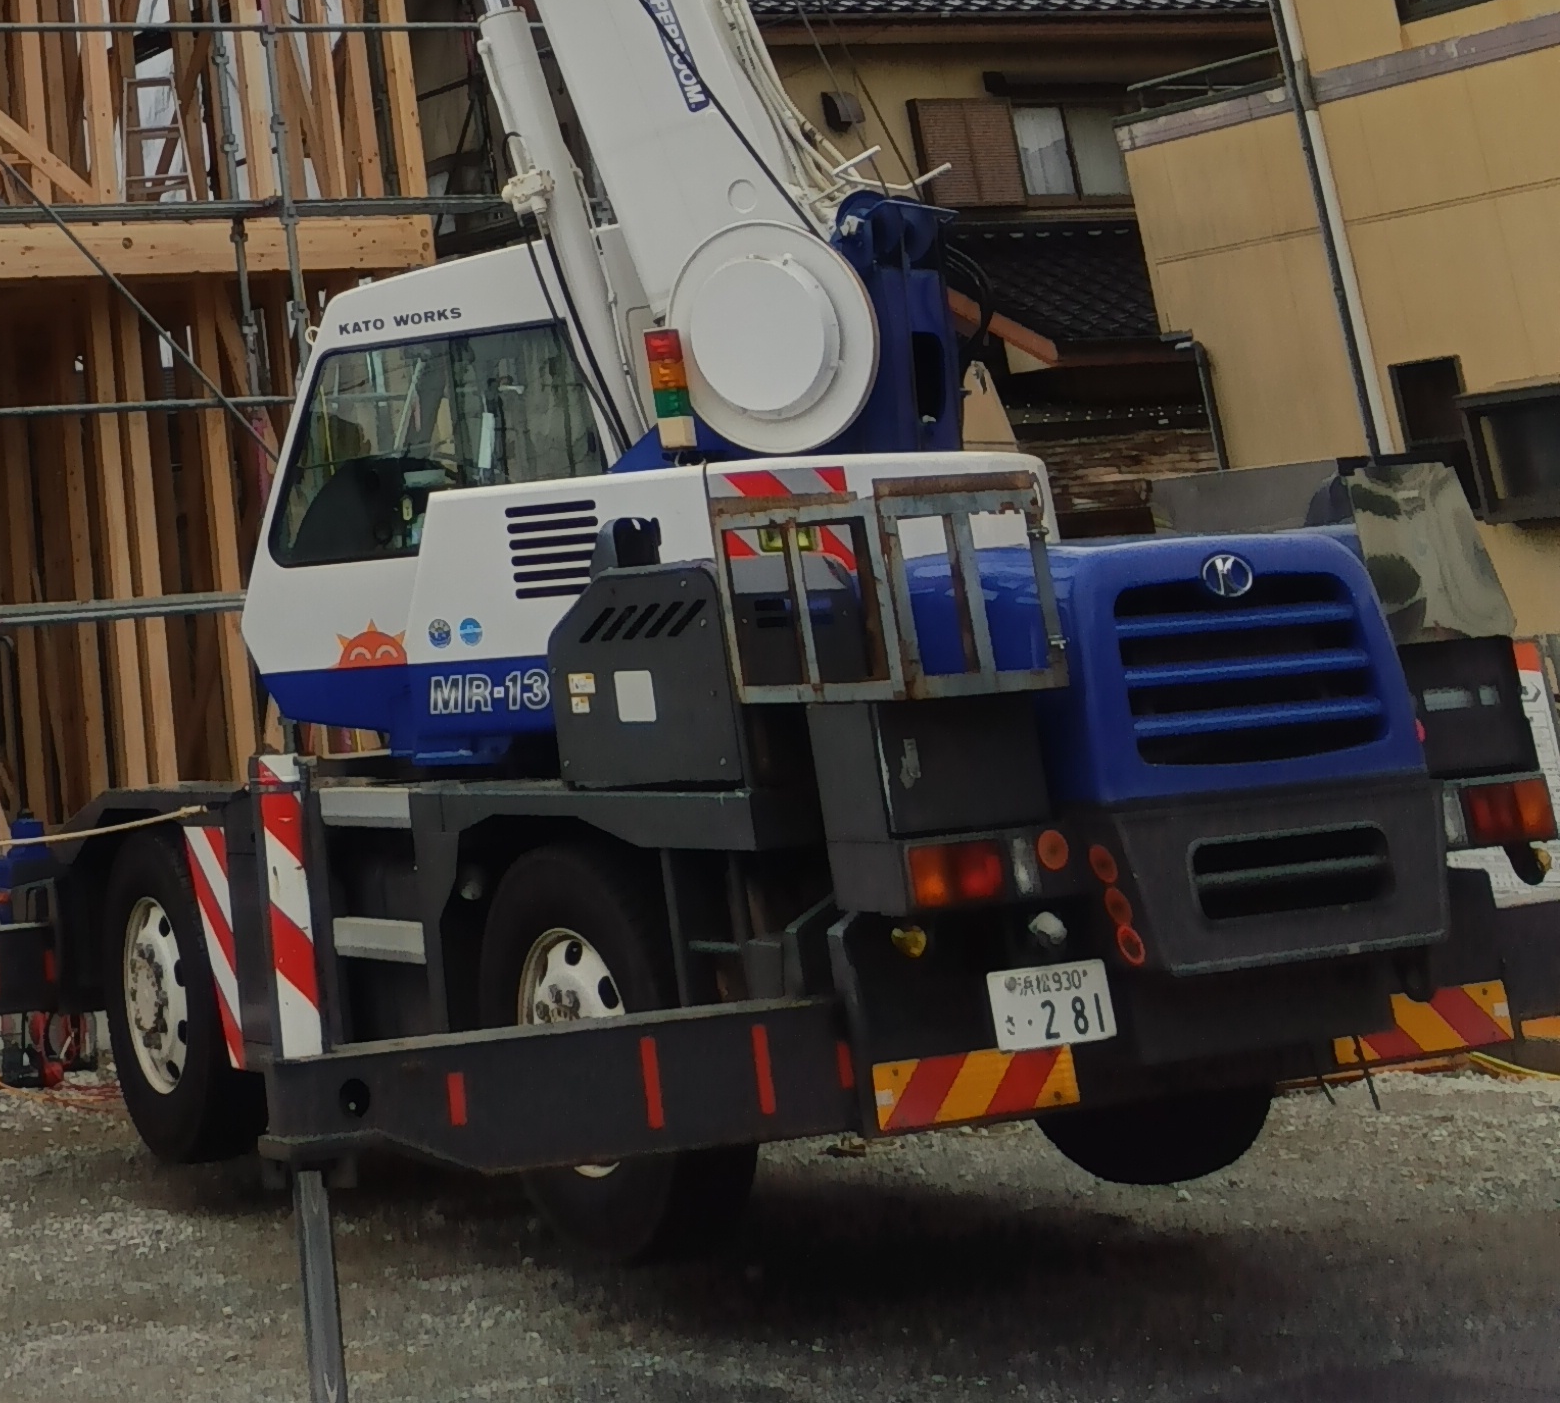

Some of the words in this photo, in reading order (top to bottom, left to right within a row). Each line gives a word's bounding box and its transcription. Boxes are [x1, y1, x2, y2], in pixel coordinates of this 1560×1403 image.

[338, 318, 385, 336] KATO
[393, 307, 462, 327] WORKS
[429, 668, 551, 715] MR-13
